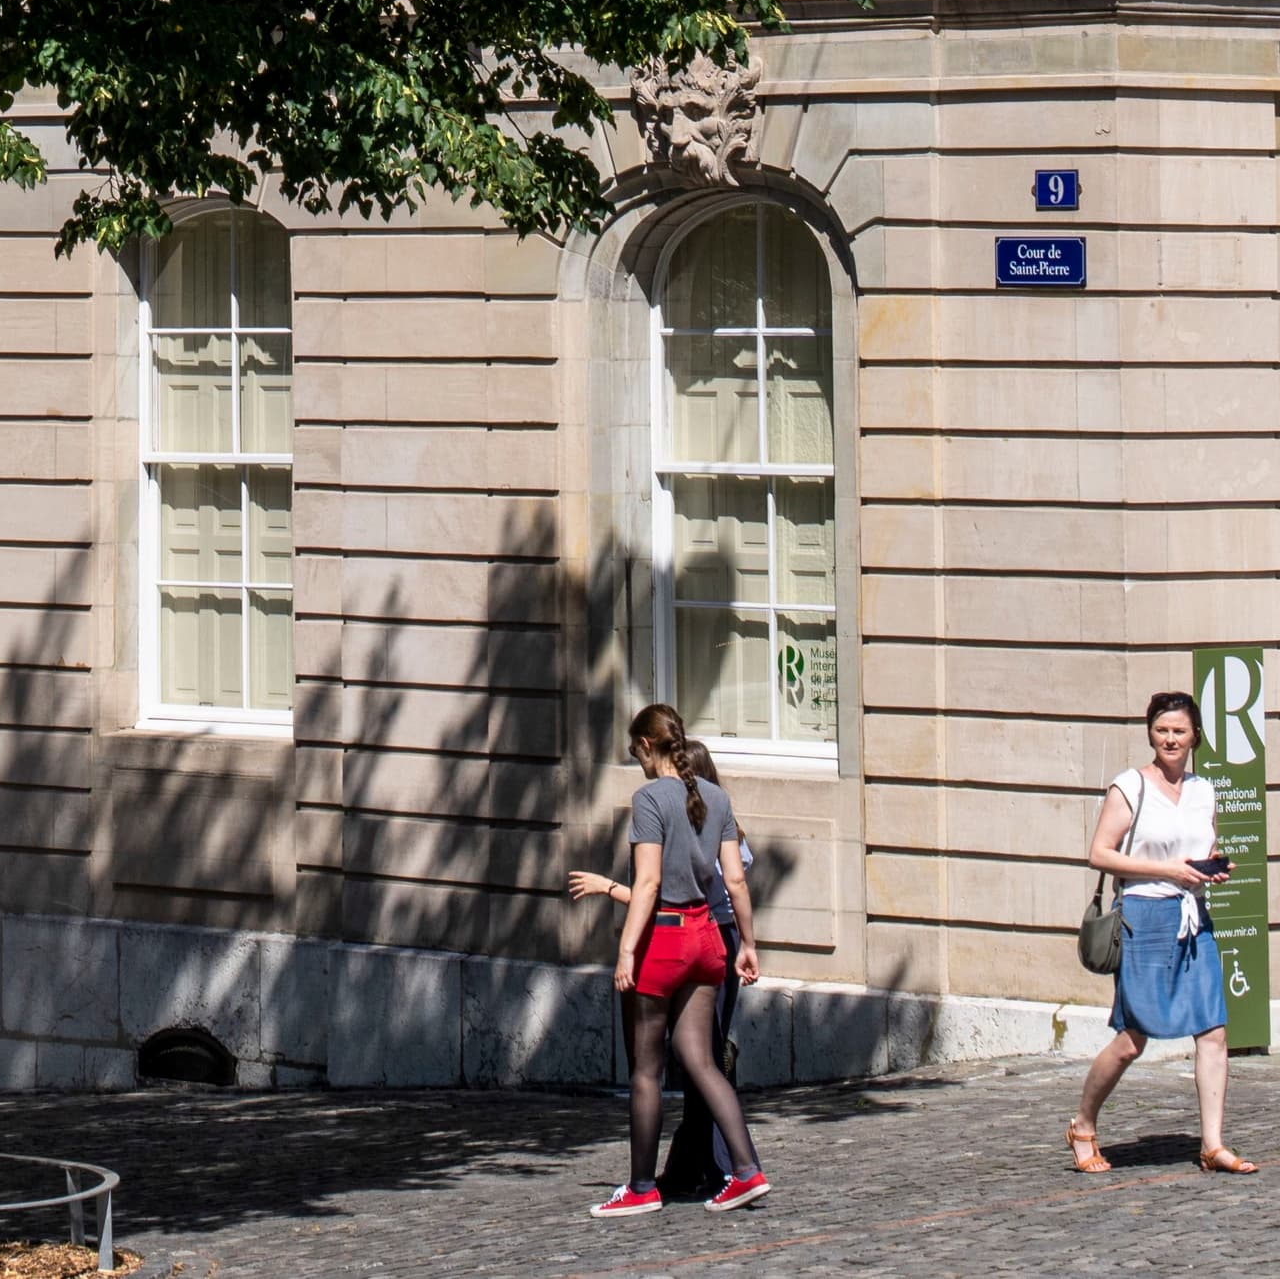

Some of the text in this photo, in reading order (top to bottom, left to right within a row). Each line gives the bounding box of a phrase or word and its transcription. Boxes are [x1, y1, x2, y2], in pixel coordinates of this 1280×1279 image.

[1048, 175, 1064, 204] 9
[1017, 244, 1062, 259] Cour de
[1009, 261, 1070, 275] Saint-Pierre
[1215, 787, 1257, 800] ernational
[1225, 800, 1263, 813] Réforme
[1213, 925, 1257, 939] www.mir.ch
